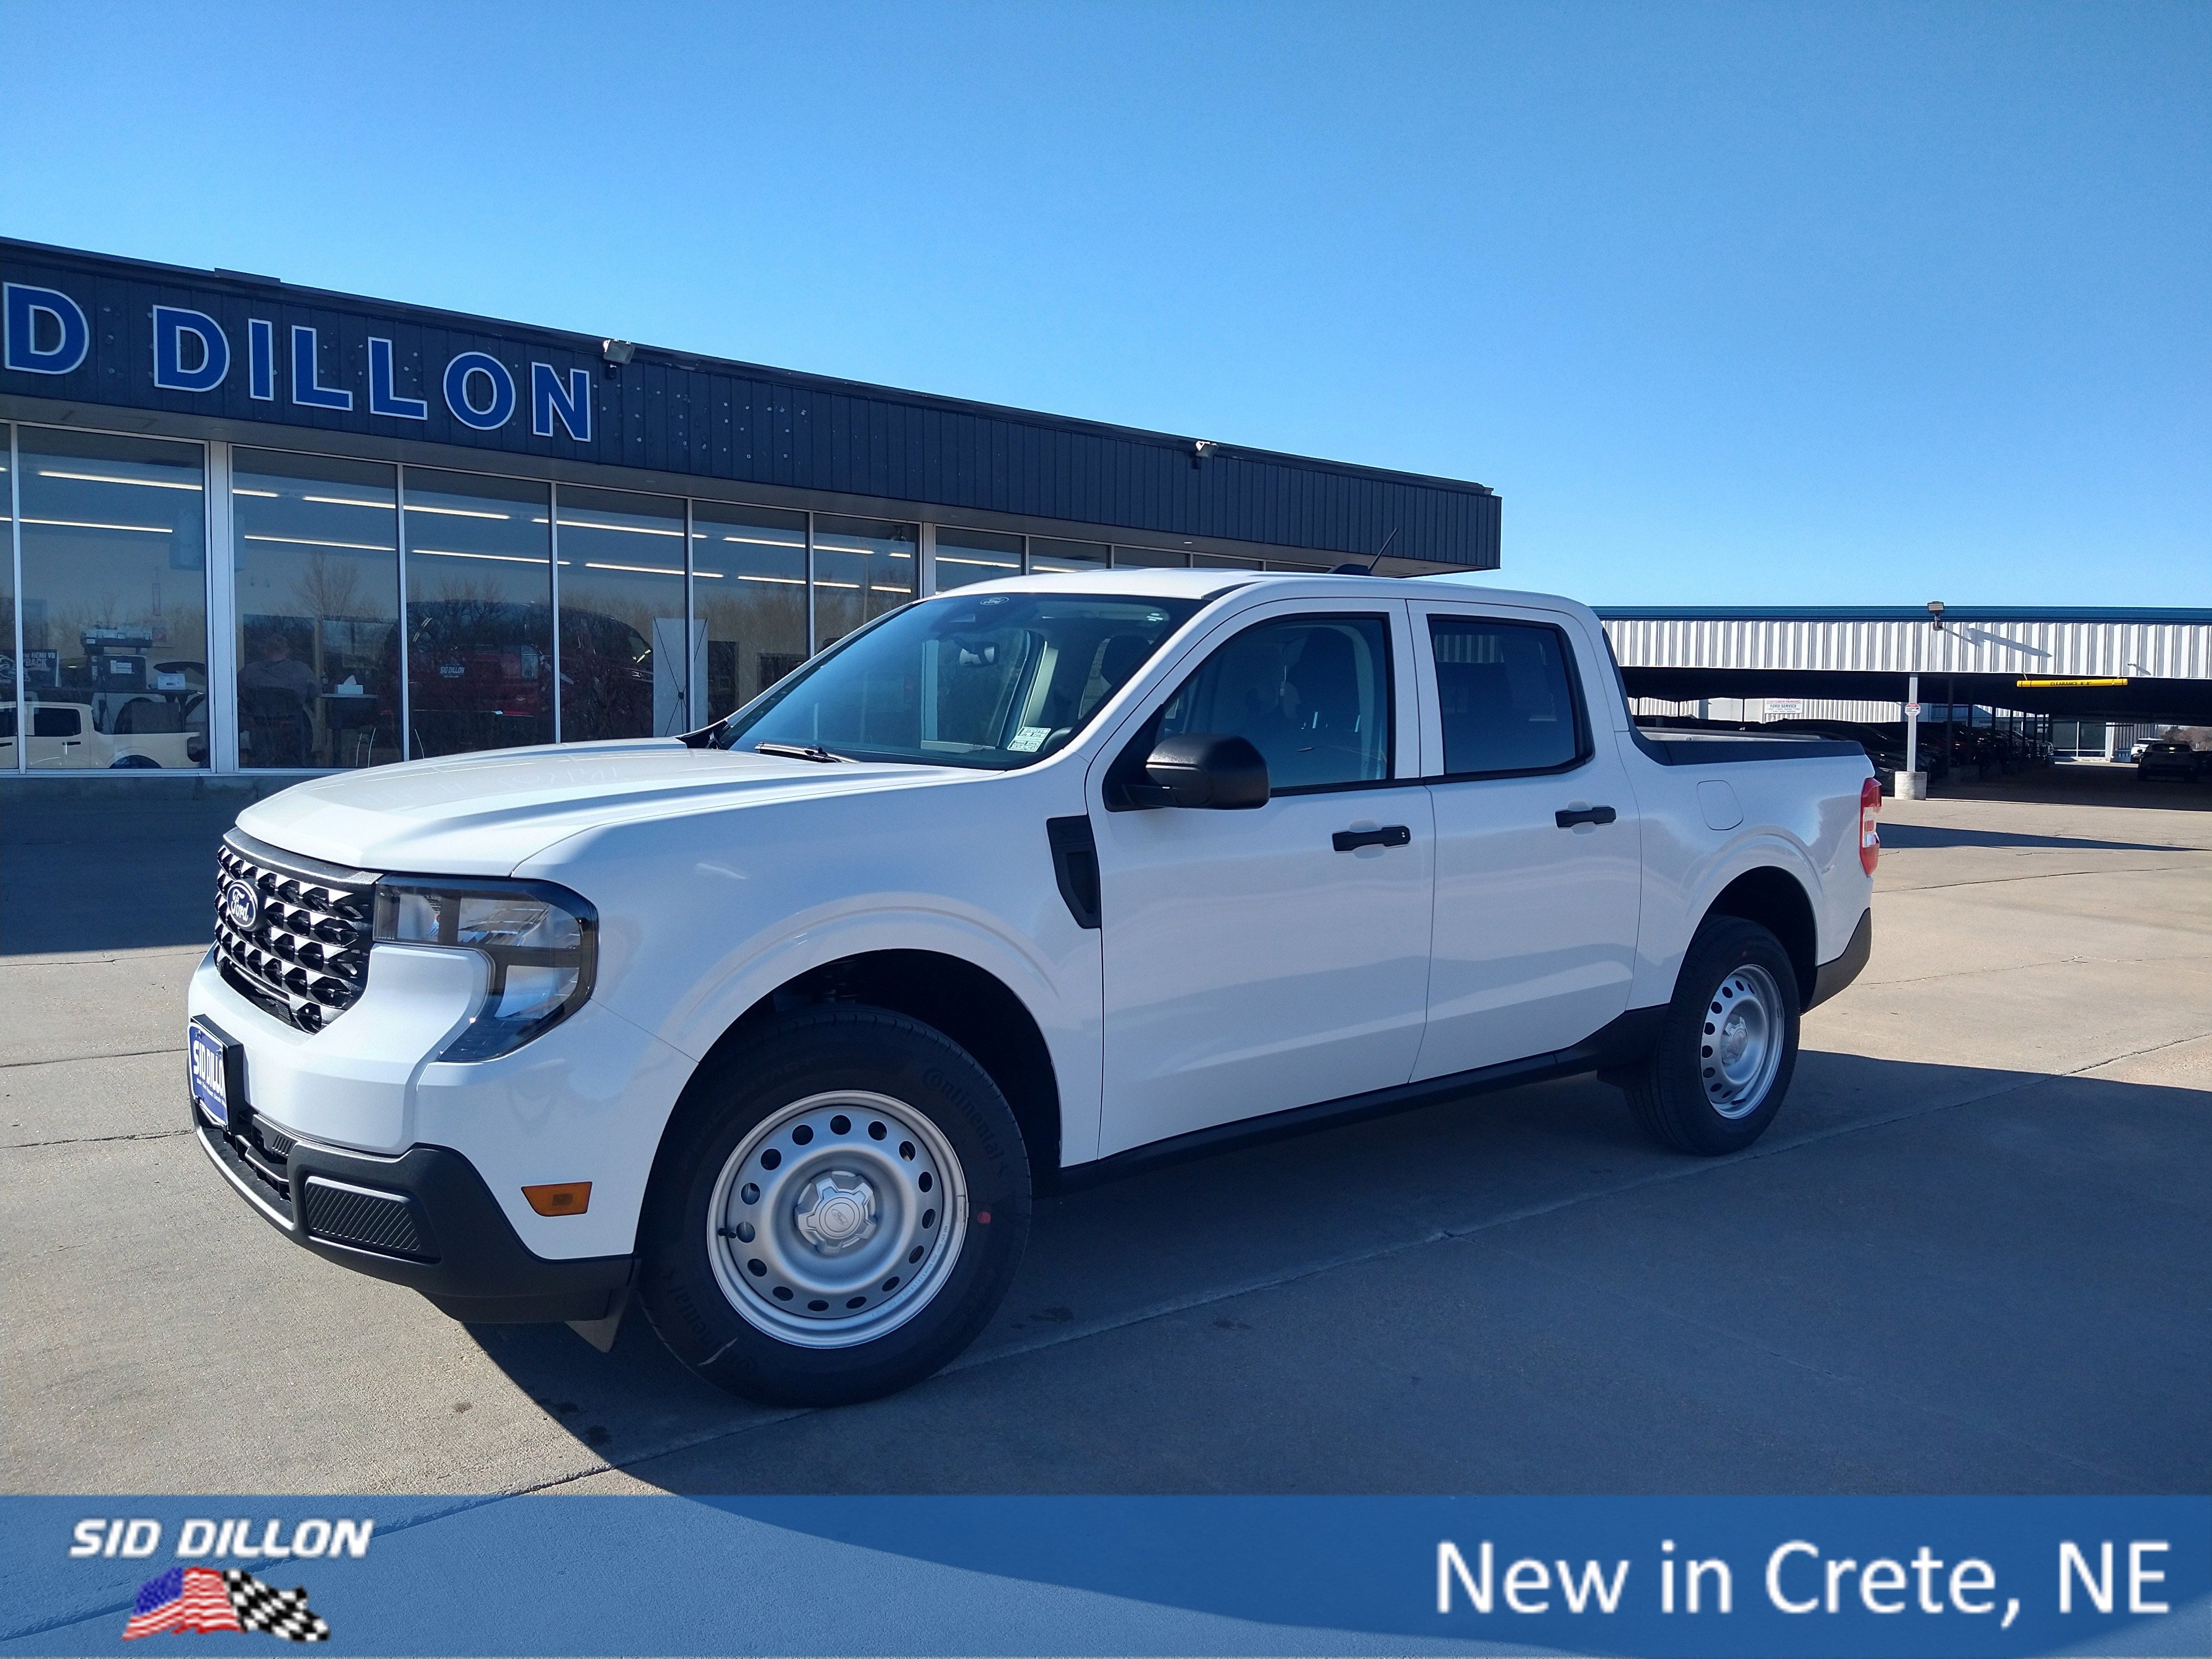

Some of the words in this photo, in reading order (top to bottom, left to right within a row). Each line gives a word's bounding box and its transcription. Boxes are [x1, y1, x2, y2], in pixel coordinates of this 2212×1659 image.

[153, 304, 591, 442] DILLON
[231, 888, 249, 922] Ford
[194, 1040, 206, 1081] SID
[922, 1067, 1005, 1161] Continental
